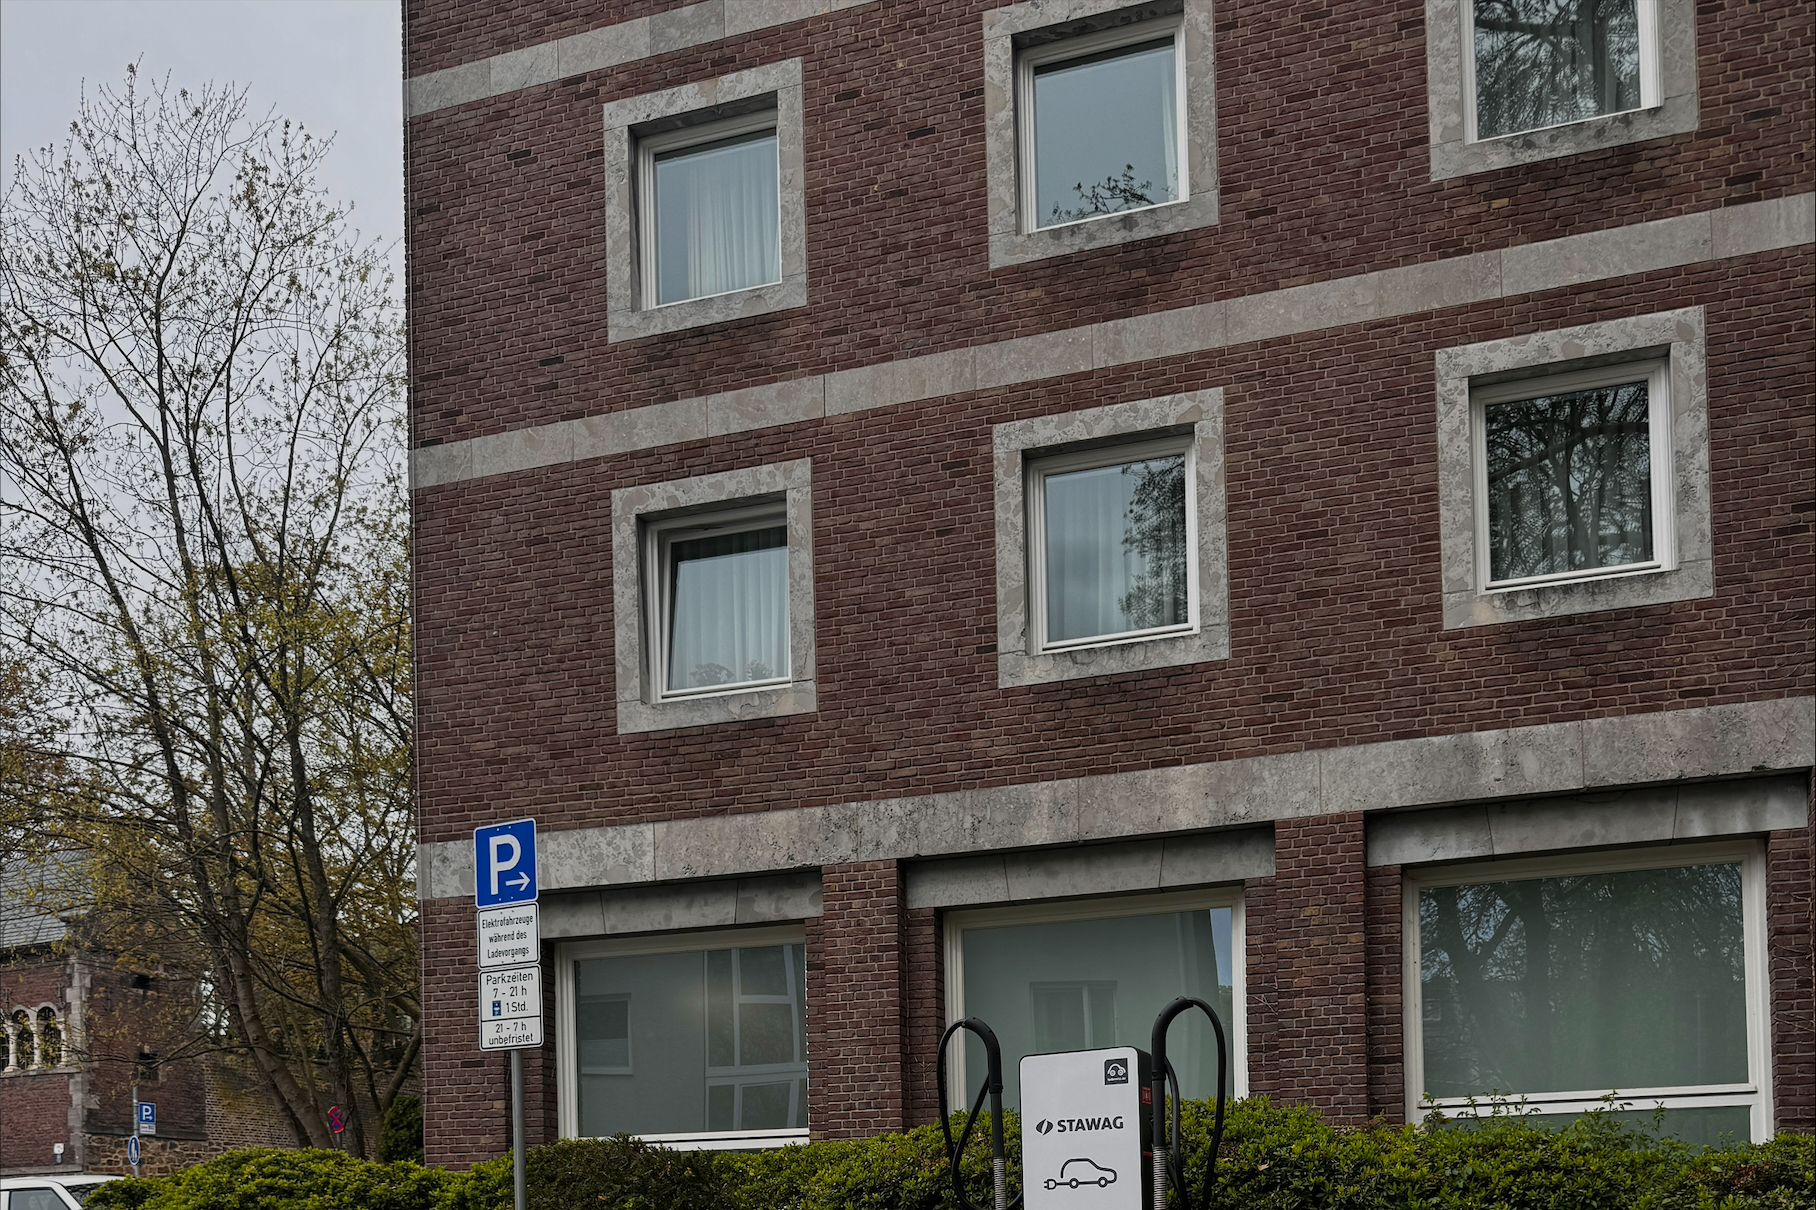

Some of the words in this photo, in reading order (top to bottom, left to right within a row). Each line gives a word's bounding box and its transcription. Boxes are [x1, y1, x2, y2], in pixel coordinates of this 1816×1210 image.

[489, 834, 521, 895] P
[482, 915, 534, 929] Elektrofahrzeuge
[488, 931, 515, 943] während
[516, 930, 528, 940] des
[487, 947, 530, 959] Ladevorgangs
[486, 972, 533, 985] Parkzeiten
[493, 988, 498, 998] 7
[510, 986, 518, 997] 21
[521, 985, 527, 996] h
[511, 1001, 528, 1012] Std.
[495, 1023, 503, 1033] 21
[513, 1022, 518, 1032] 7
[521, 1021, 526, 1031] h
[489, 1033, 533, 1045] unbefristet
[142, 1106, 152, 1120] P
[1057, 1116, 1124, 1133] STAWAG
